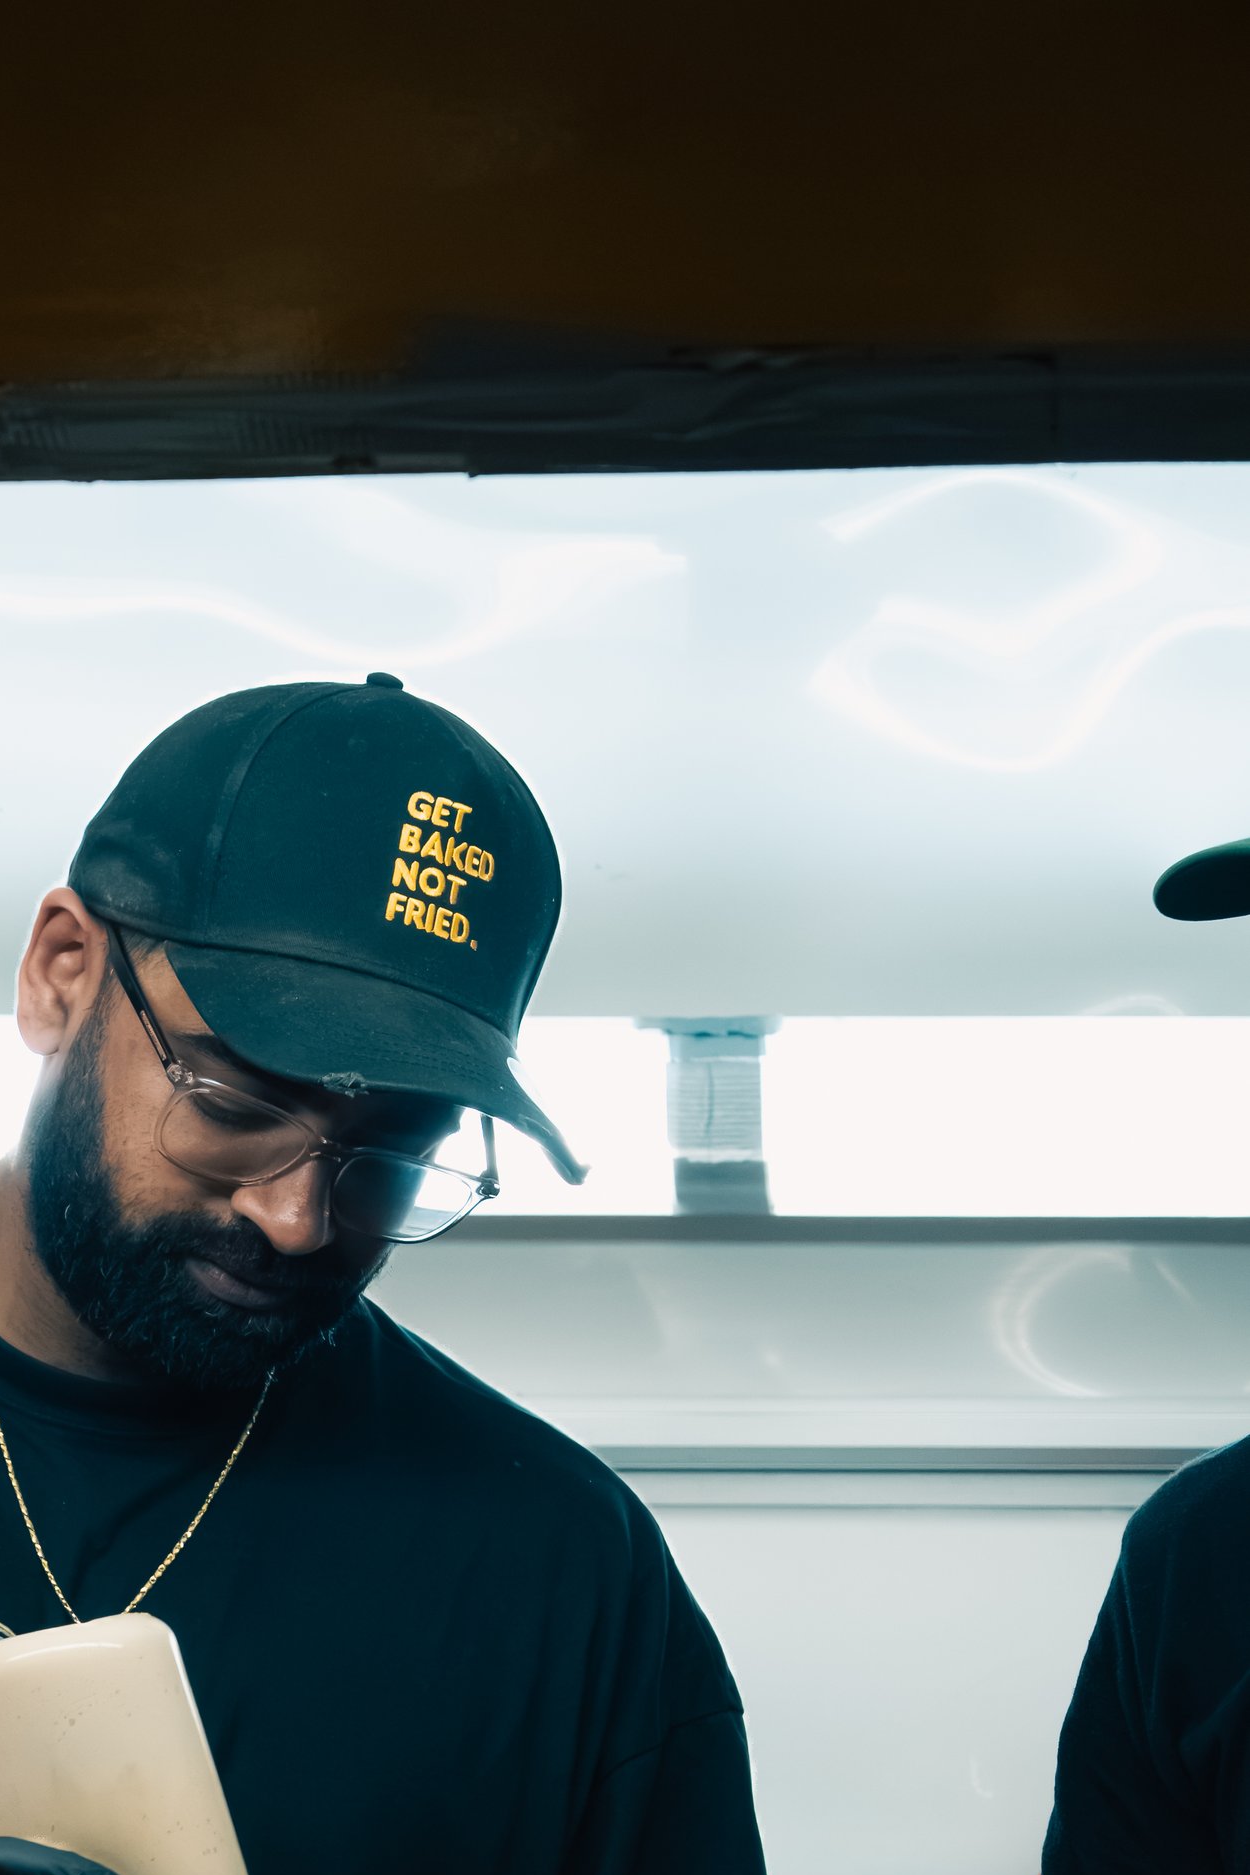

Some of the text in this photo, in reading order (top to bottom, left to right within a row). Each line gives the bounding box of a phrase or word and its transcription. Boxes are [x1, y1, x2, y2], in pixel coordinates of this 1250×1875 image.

[407, 791, 473, 834] GET
[399, 823, 495, 882] BAKED
[391, 857, 467, 905] NOT
[384, 892, 478, 951] FRIED.
